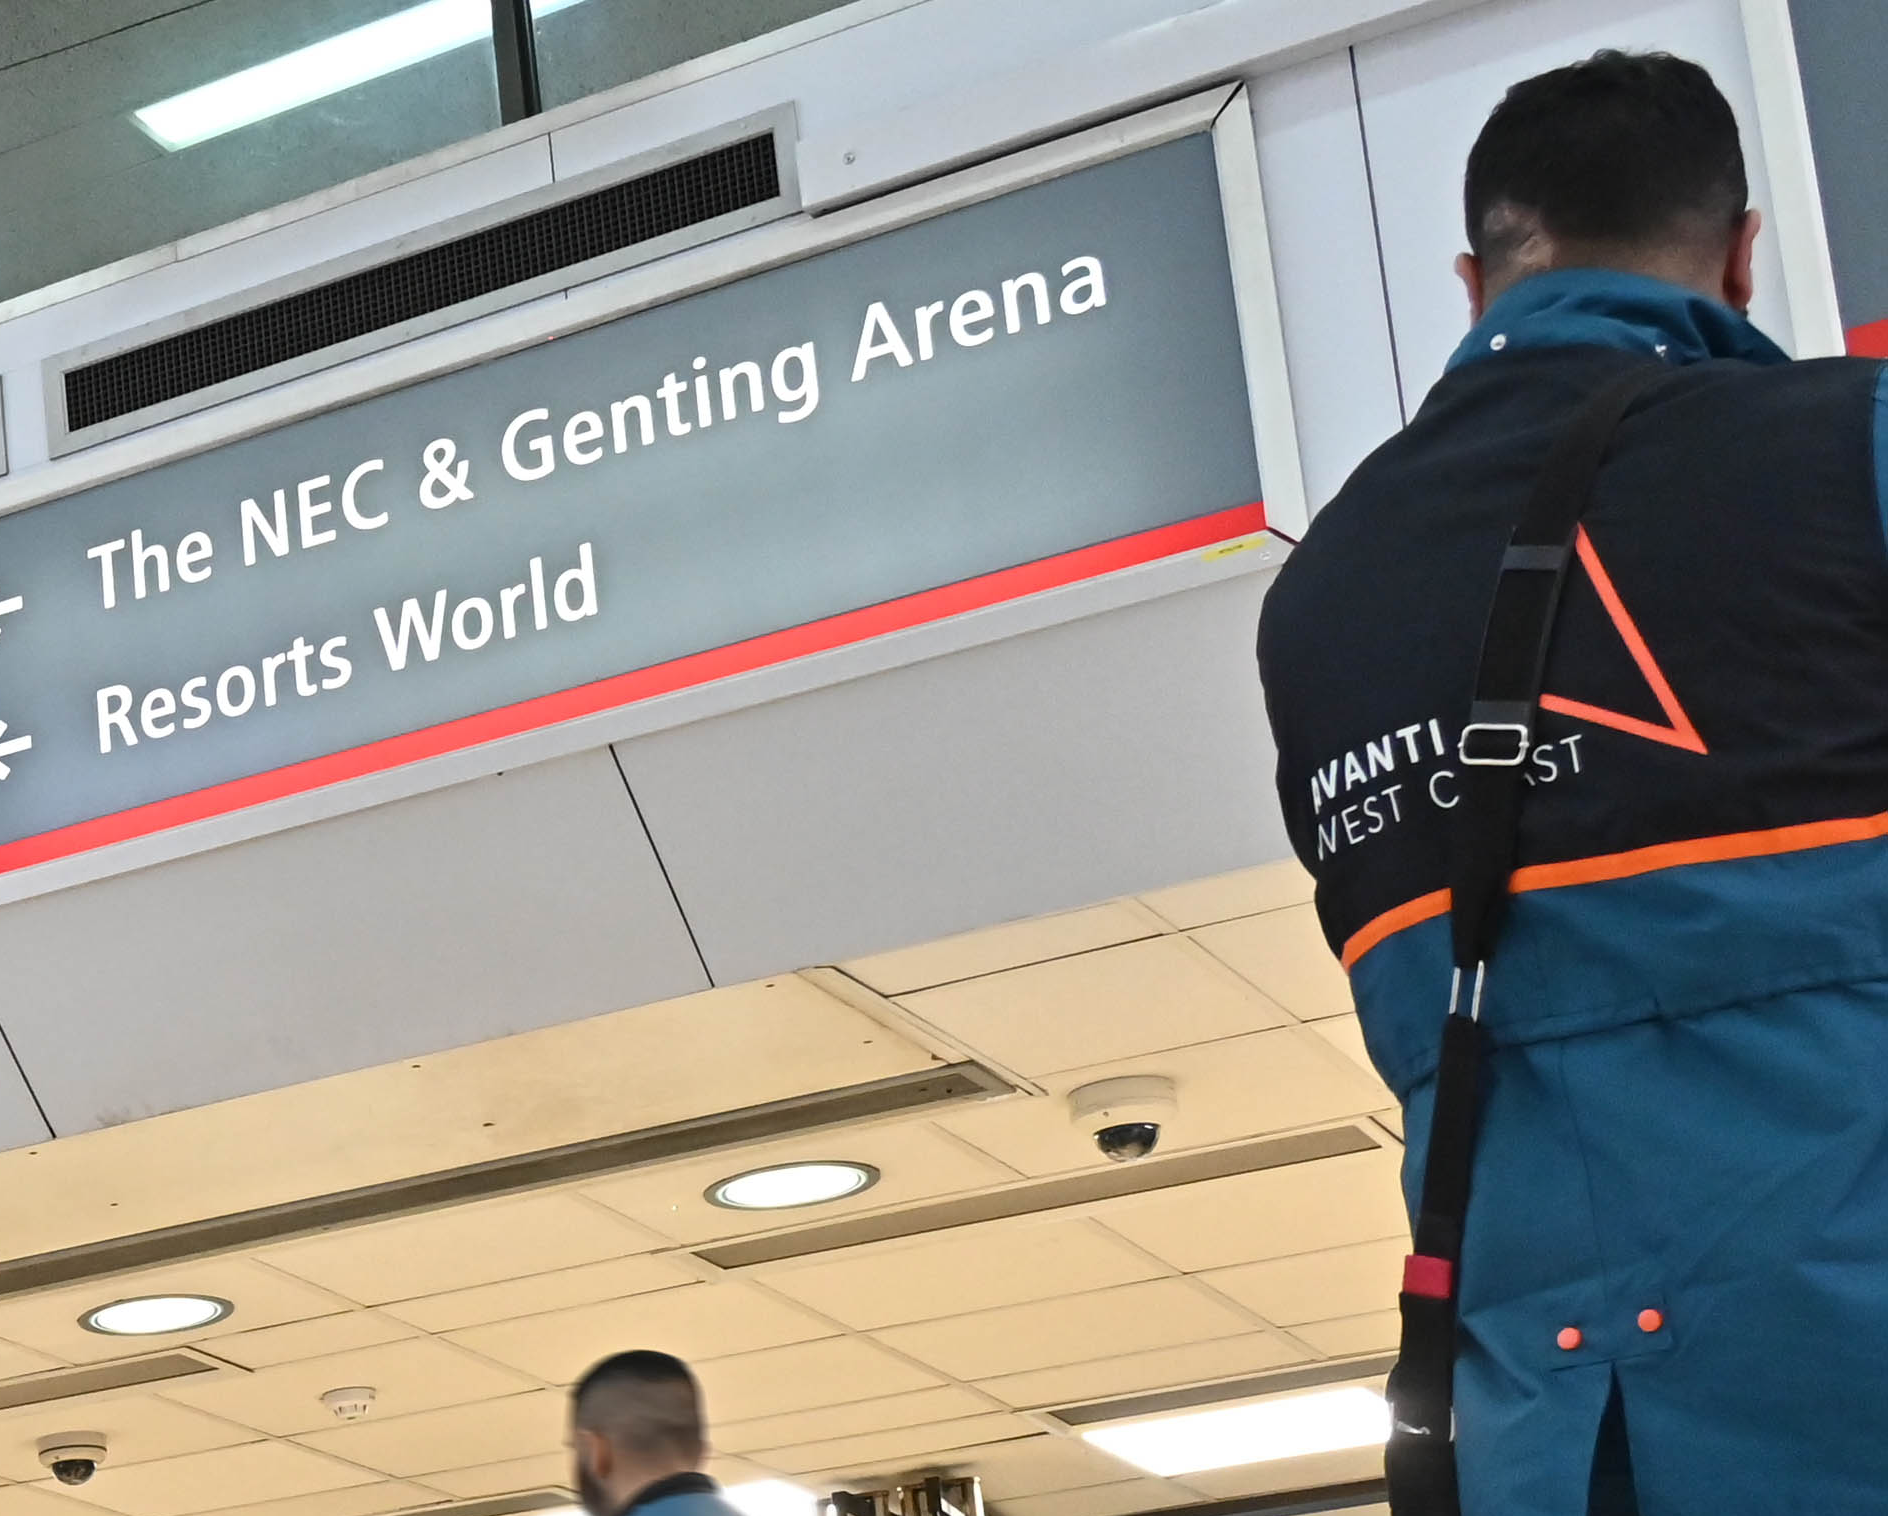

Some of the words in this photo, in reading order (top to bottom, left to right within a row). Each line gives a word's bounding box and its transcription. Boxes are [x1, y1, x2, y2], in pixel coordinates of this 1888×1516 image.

[86, 528, 214, 610] The
[239, 458, 390, 568] NEC
[418, 437, 475, 510] &
[500, 341, 820, 482] Genting
[850, 254, 1108, 383] Arena
[95, 635, 353, 755] Resorts
[373, 541, 599, 673] World
[1429, 733, 1583, 810] CST
